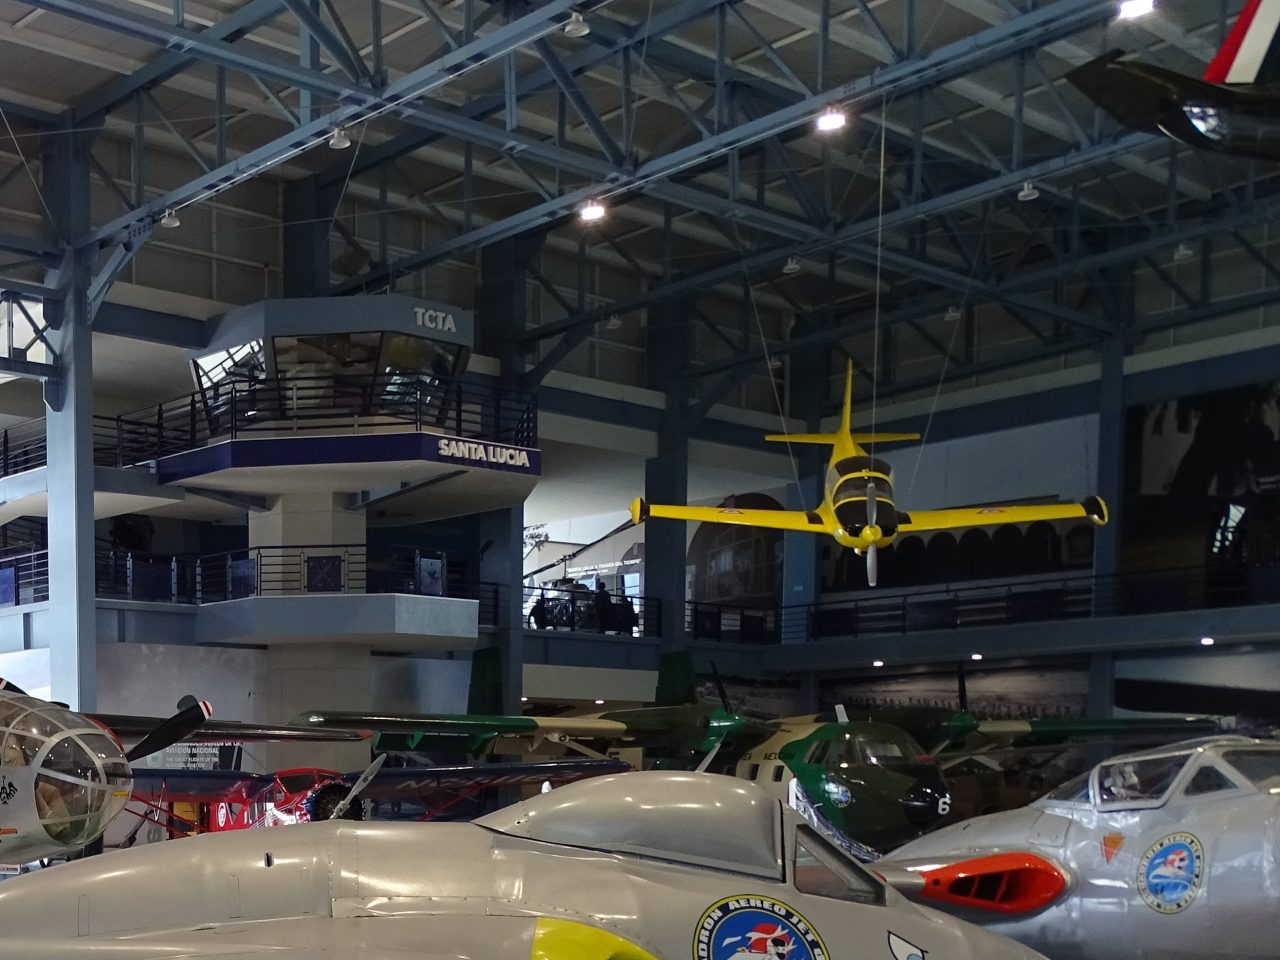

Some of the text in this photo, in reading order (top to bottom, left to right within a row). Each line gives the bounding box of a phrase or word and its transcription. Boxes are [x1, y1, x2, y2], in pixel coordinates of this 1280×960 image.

[413, 307, 457, 333] TCTA
[438, 439, 530, 468] SANTA LUCIA
[938, 798, 951, 815] 6
[728, 899, 787, 916] AEREO
[789, 915, 819, 943] JET
